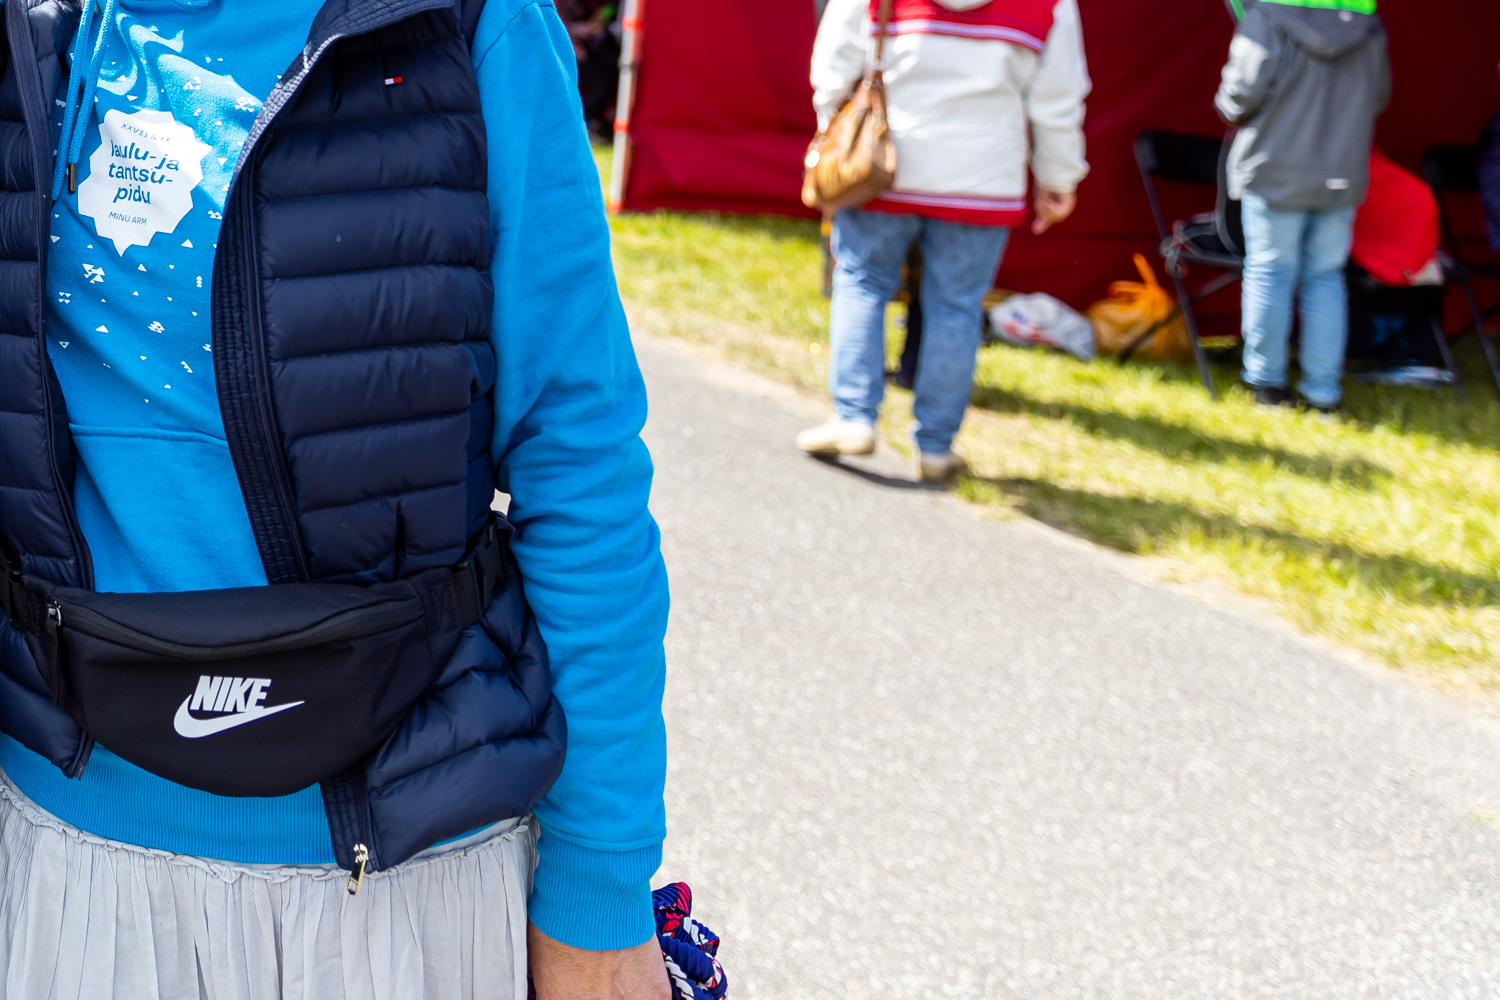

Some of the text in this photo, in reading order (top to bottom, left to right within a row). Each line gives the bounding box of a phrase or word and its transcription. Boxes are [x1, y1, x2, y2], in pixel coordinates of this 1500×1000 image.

[110, 139, 180, 171] laulu- ja
[108, 162, 173, 184] tantsu-
[112, 183, 151, 204] pidu
[108, 211, 148, 226] MINU ARM
[190, 675, 272, 713] NIKE
